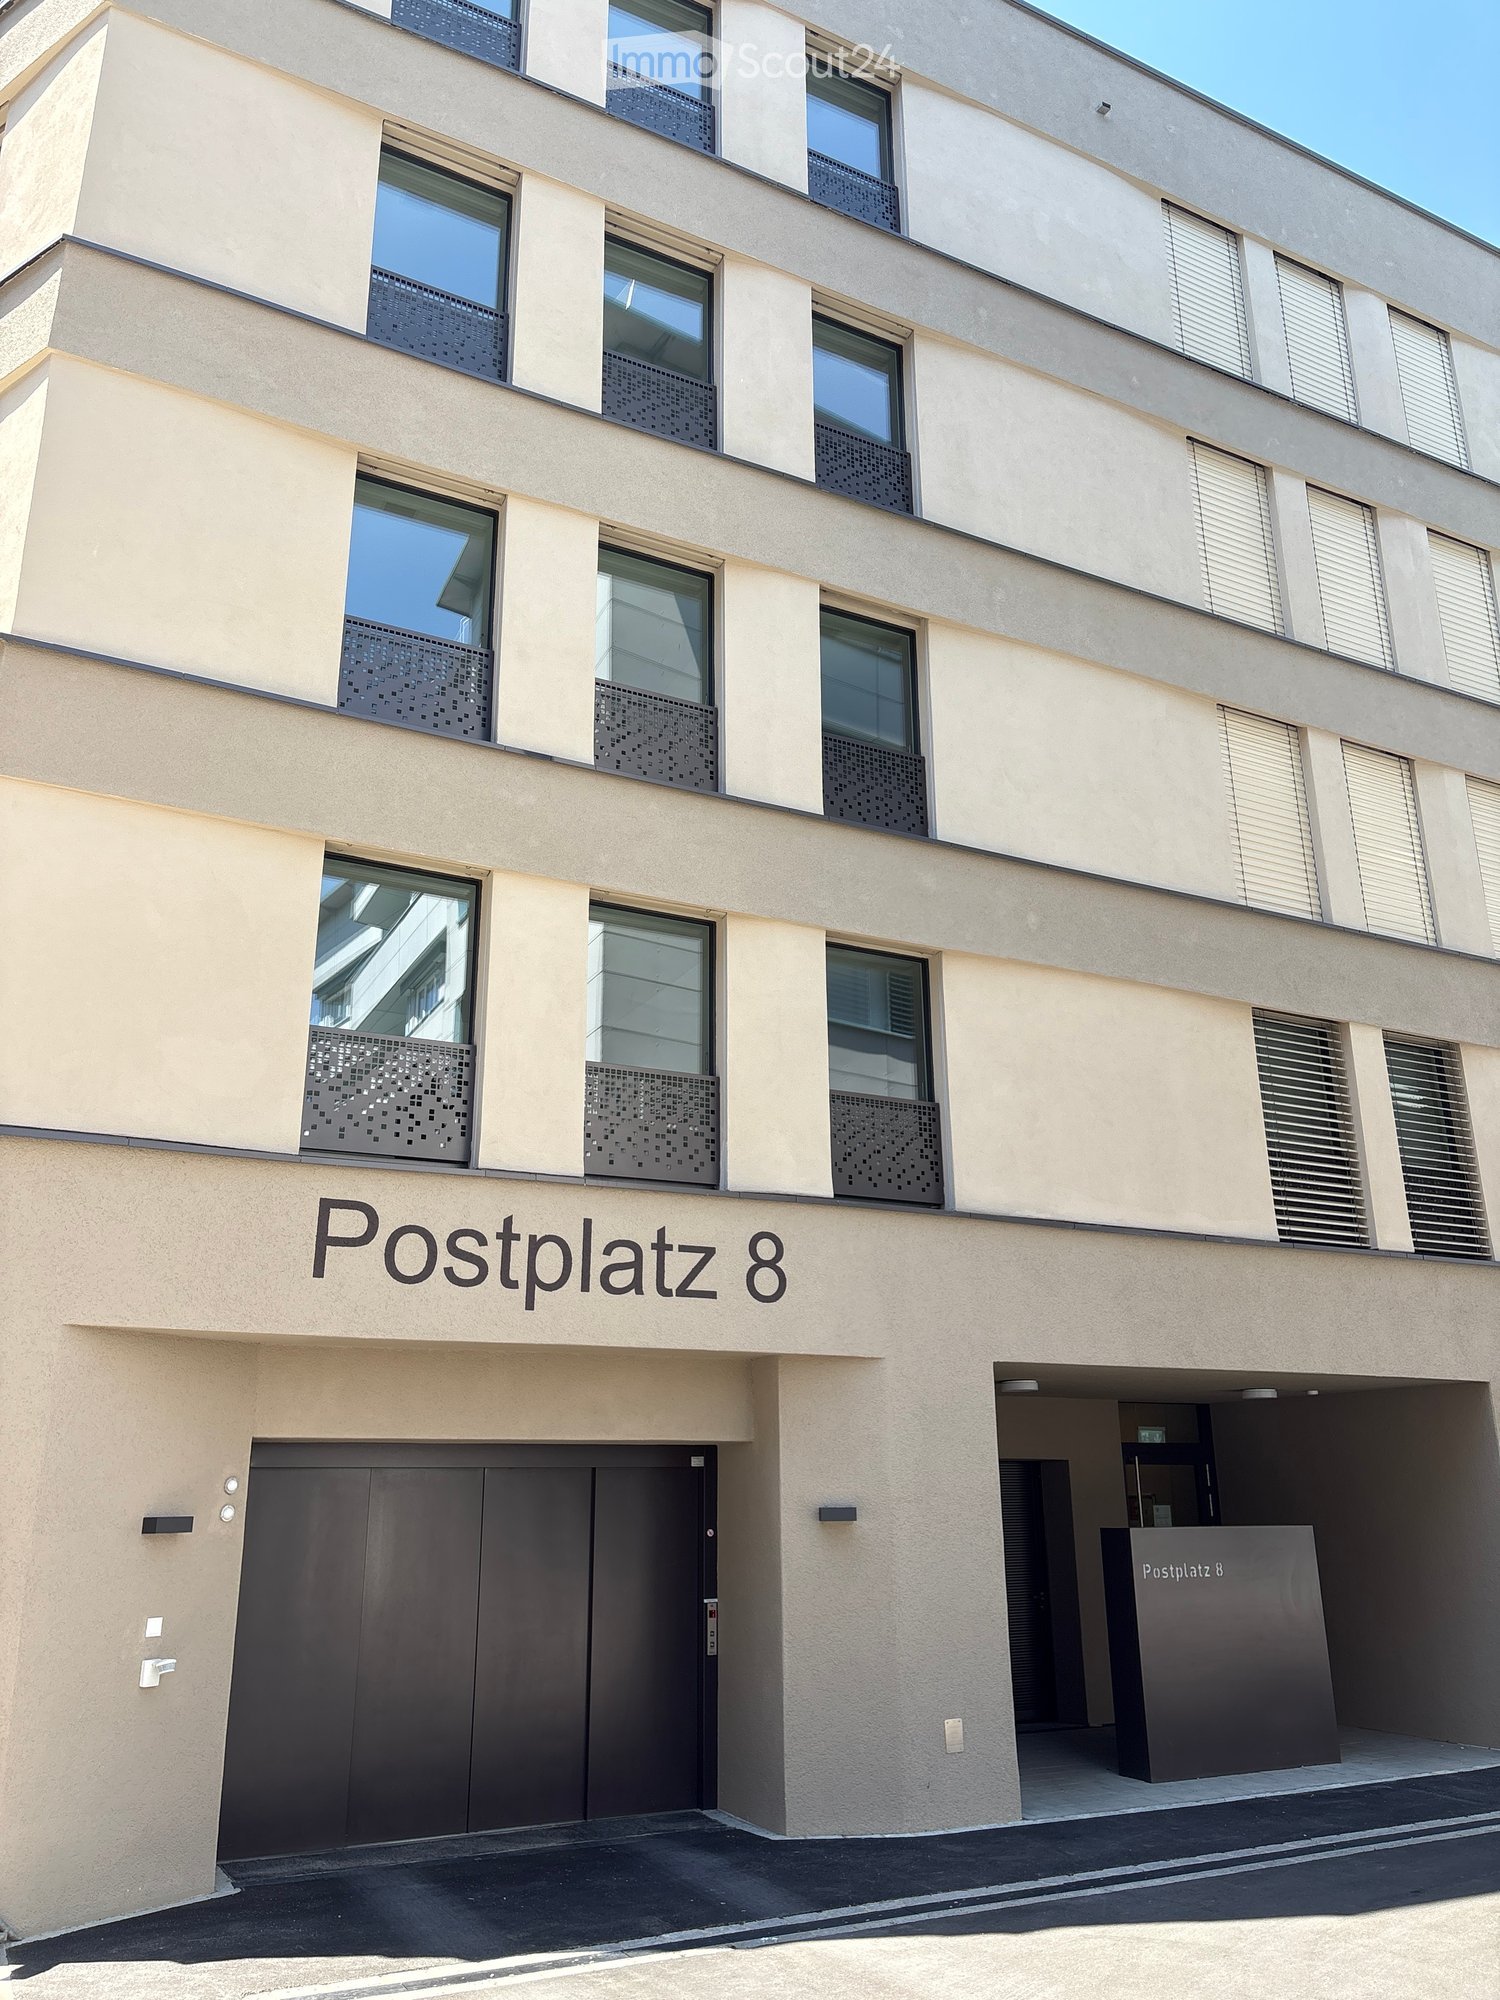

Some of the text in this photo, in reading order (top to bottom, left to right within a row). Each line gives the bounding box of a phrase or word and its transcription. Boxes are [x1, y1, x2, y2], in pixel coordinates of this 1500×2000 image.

[312, 1197, 787, 1311] Postplatz 8
[1142, 1561, 1224, 1582] Postplatz 8
